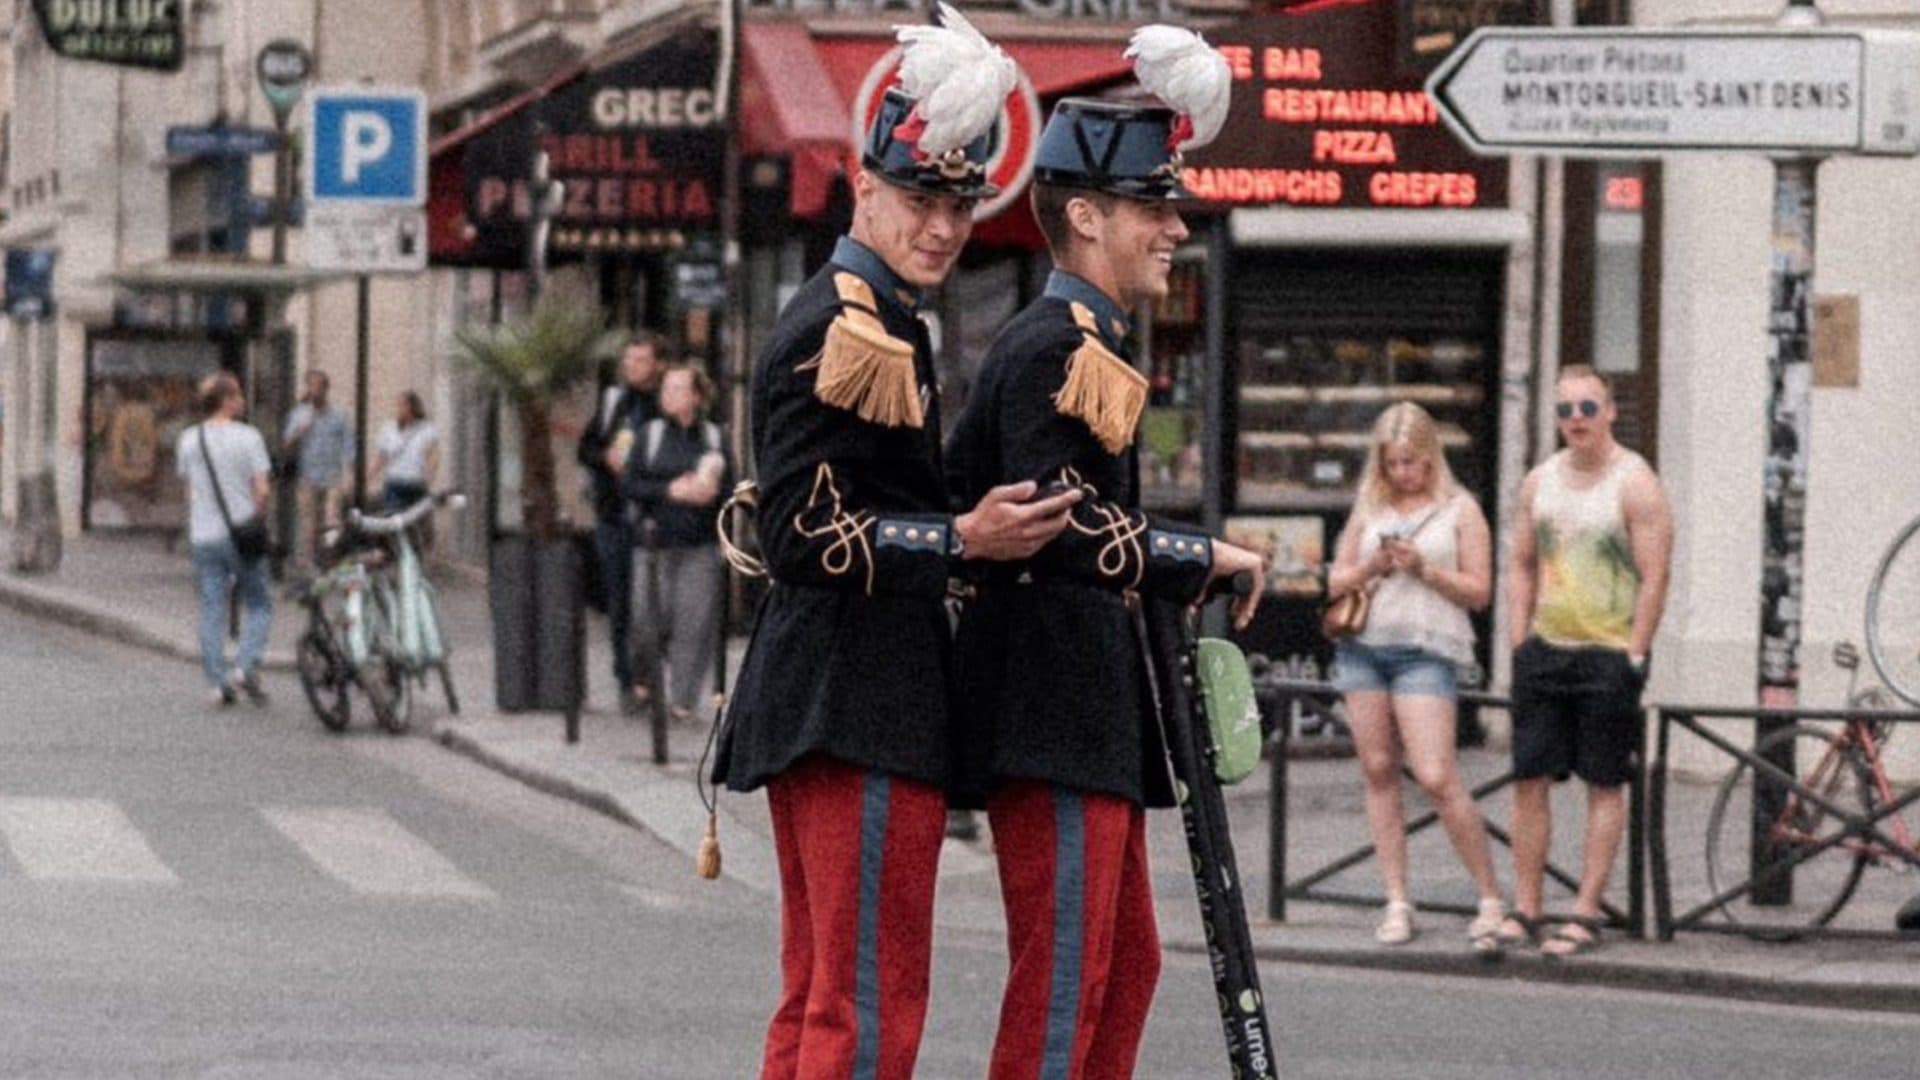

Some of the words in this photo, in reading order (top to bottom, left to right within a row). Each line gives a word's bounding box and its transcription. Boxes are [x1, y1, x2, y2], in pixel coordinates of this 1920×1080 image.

[1263, 47, 1322, 80] BAR
[593, 87, 714, 127] GREC
[1263, 87, 1438, 123] RESTAURANT
[1773, 82, 1850, 109] DENIS
[341, 110, 392, 184] P
[1314, 130, 1395, 163] PIZZA
[478, 176, 714, 219] PIZERIA
[1370, 171, 1477, 206] CREPES
